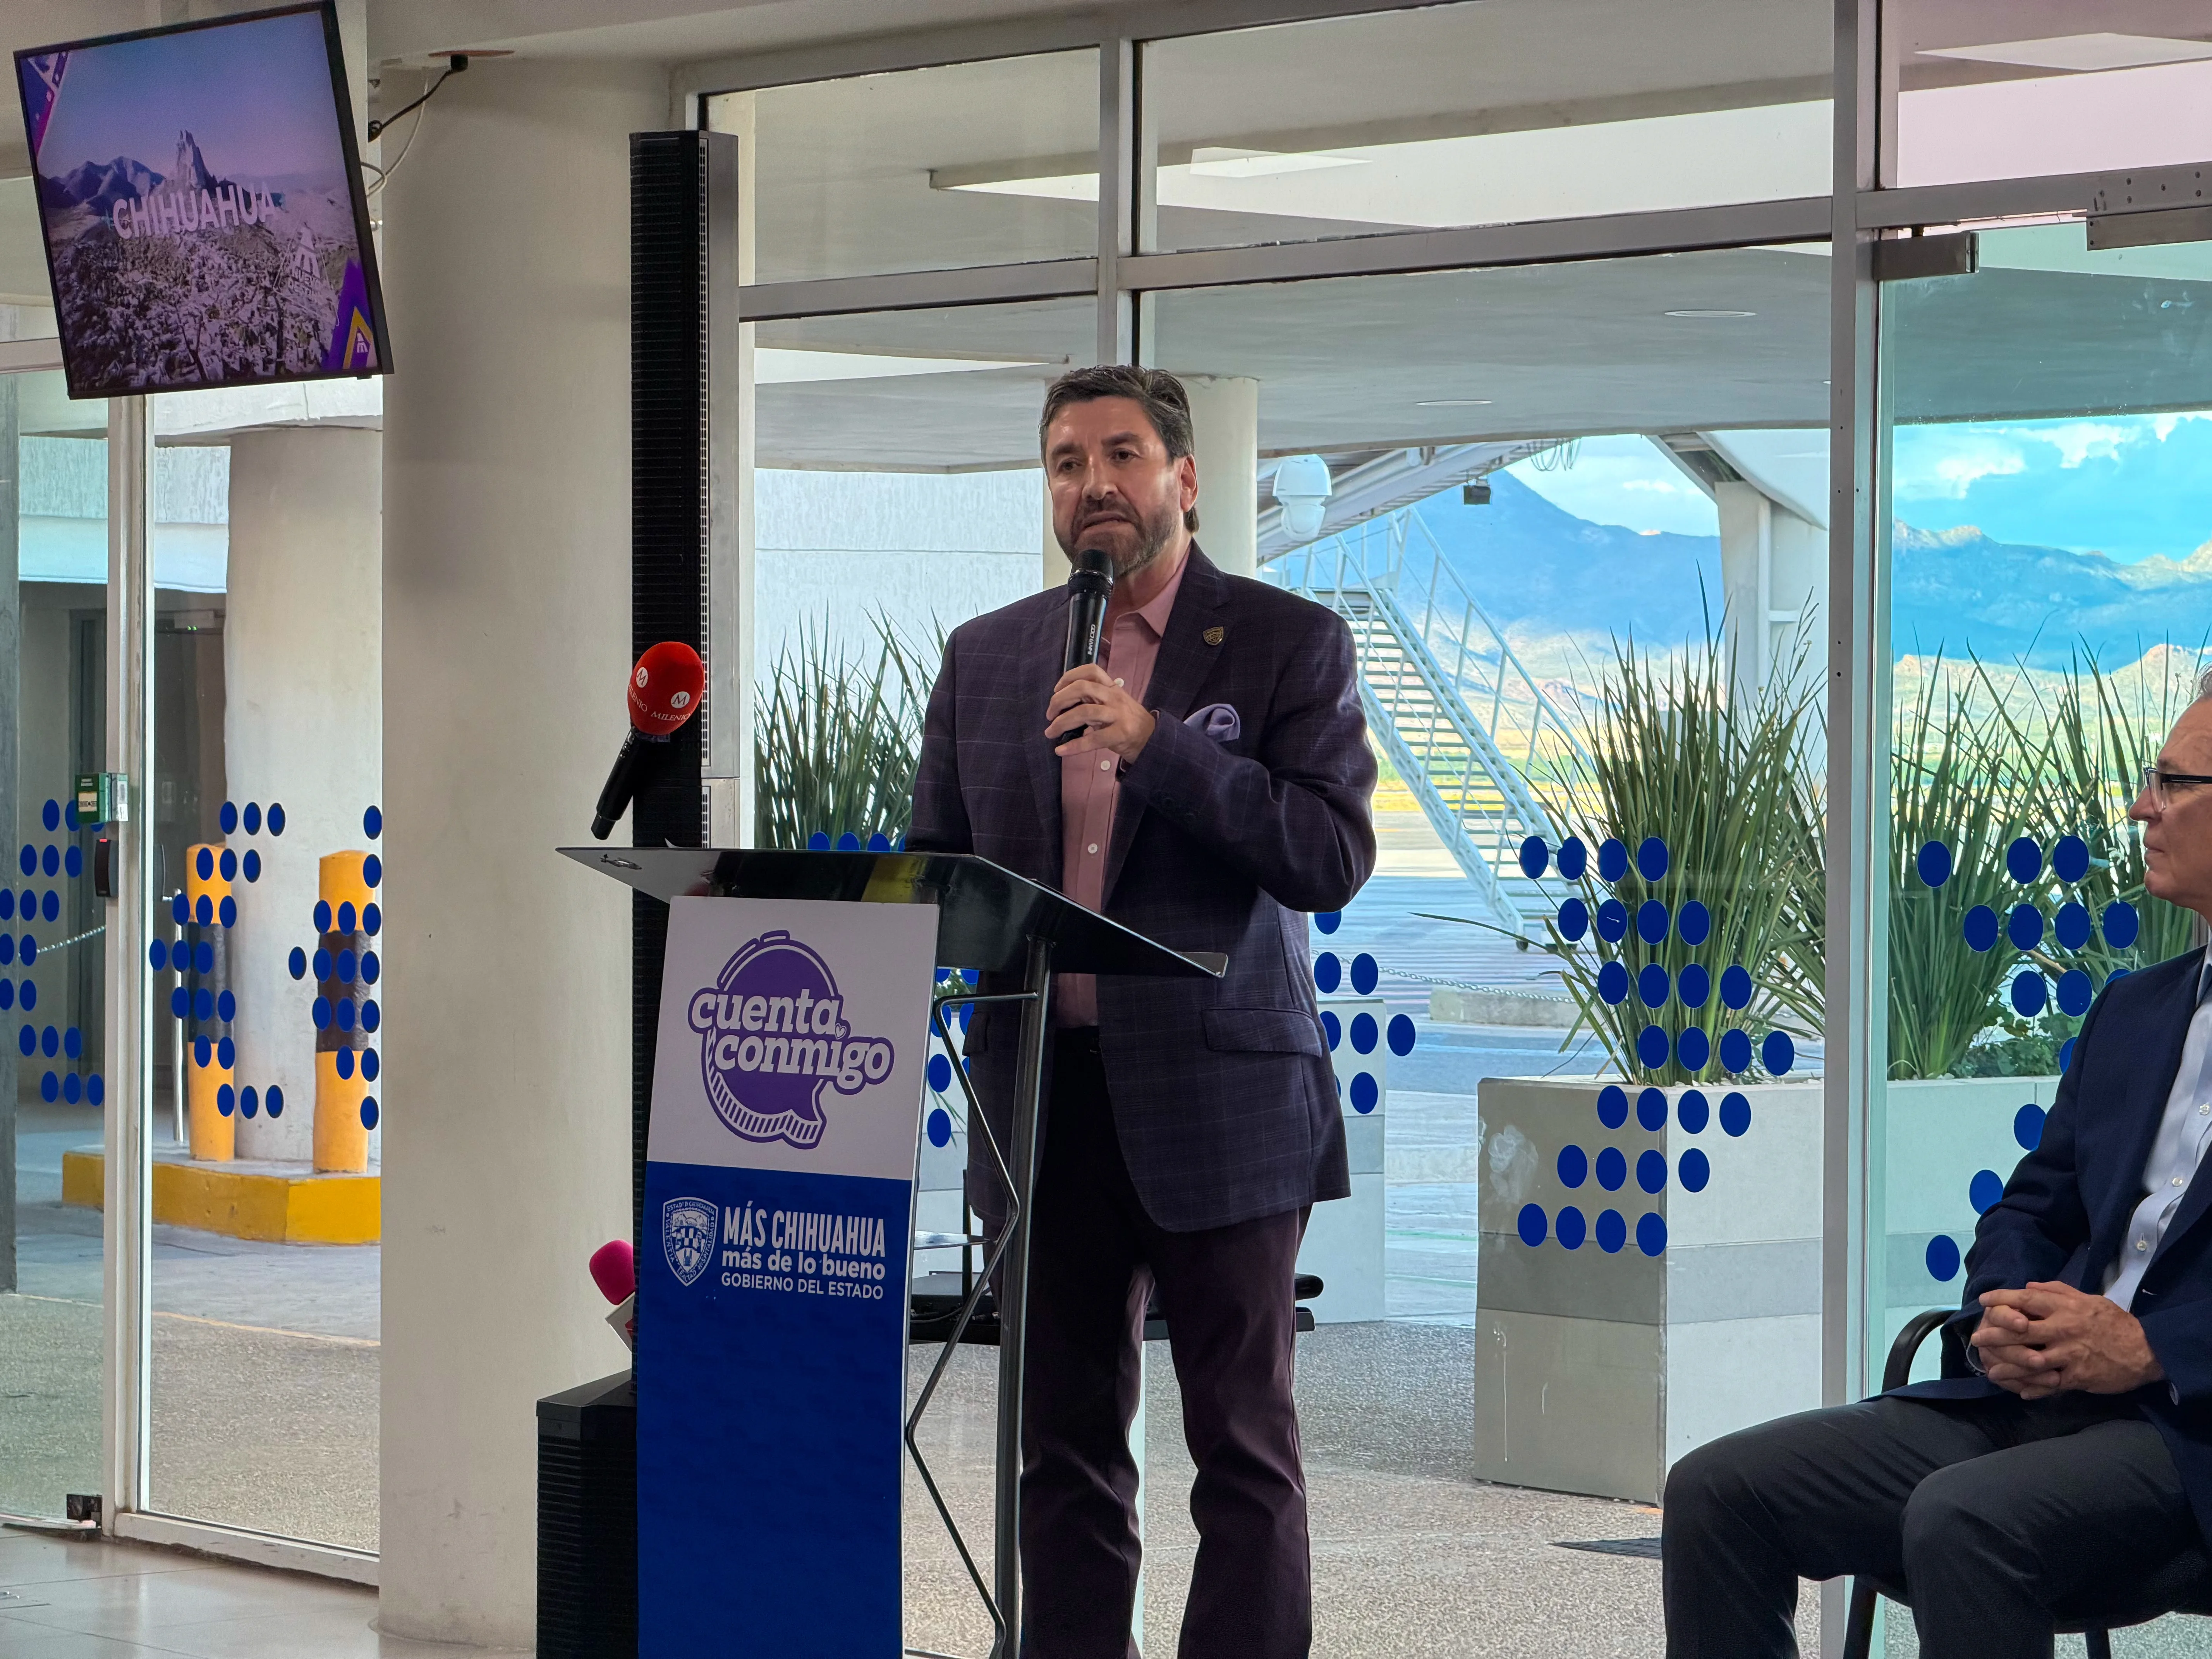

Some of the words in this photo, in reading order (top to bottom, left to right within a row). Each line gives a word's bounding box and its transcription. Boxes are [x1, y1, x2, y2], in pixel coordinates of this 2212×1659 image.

[113, 183, 274, 239] CHIHUAHUA
[651, 711, 691, 721] MILENIO
[672, 694, 687, 705] M
[692, 988, 840, 1035] cuenta
[715, 1034, 891, 1089] conmigo
[723, 1200, 767, 1247] MÁS
[771, 1210, 886, 1257] CHIHUAHUA
[722, 1246, 762, 1270] más
[768, 1249, 792, 1272] de
[798, 1252, 816, 1274] lo
[822, 1254, 886, 1280] bueno
[721, 1272, 793, 1291] GOBIERNO
[798, 1279, 824, 1295] DEL
[828, 1281, 883, 1300] ESTADO
